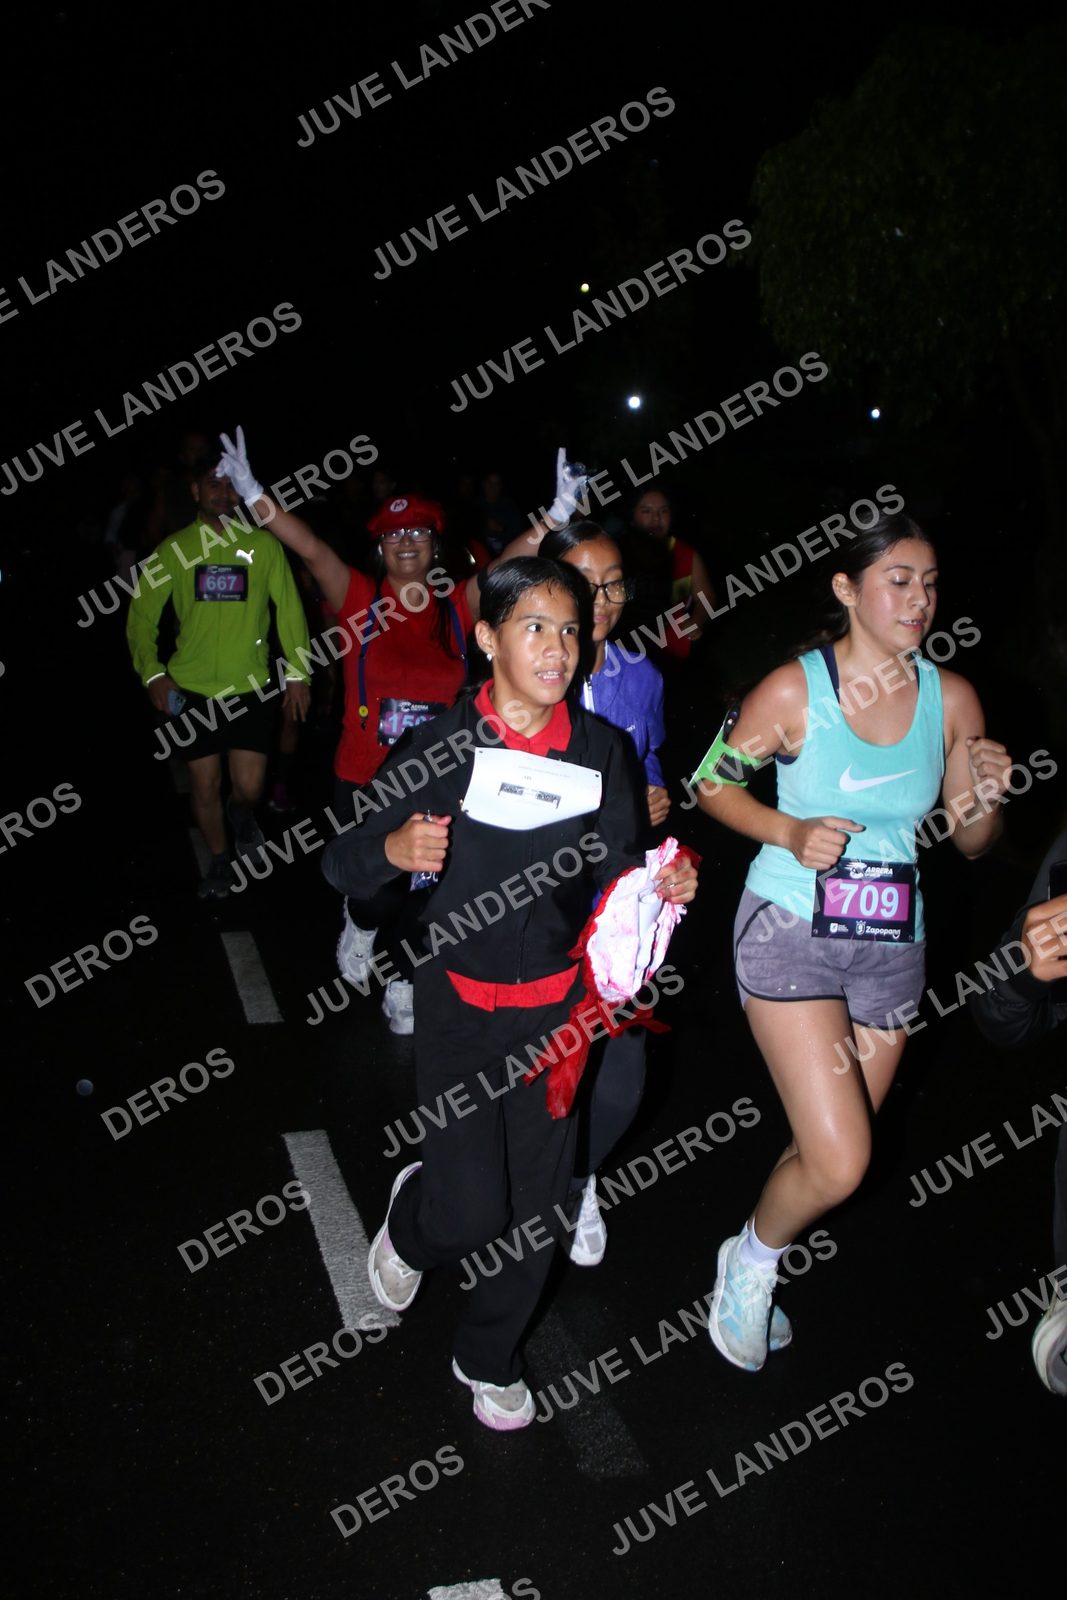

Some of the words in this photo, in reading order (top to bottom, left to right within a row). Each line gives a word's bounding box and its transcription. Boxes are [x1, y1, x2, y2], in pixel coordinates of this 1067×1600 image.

[206, 575, 237, 591] 667
[388, 713, 436, 733] 15
[839, 883, 900, 918] 709
